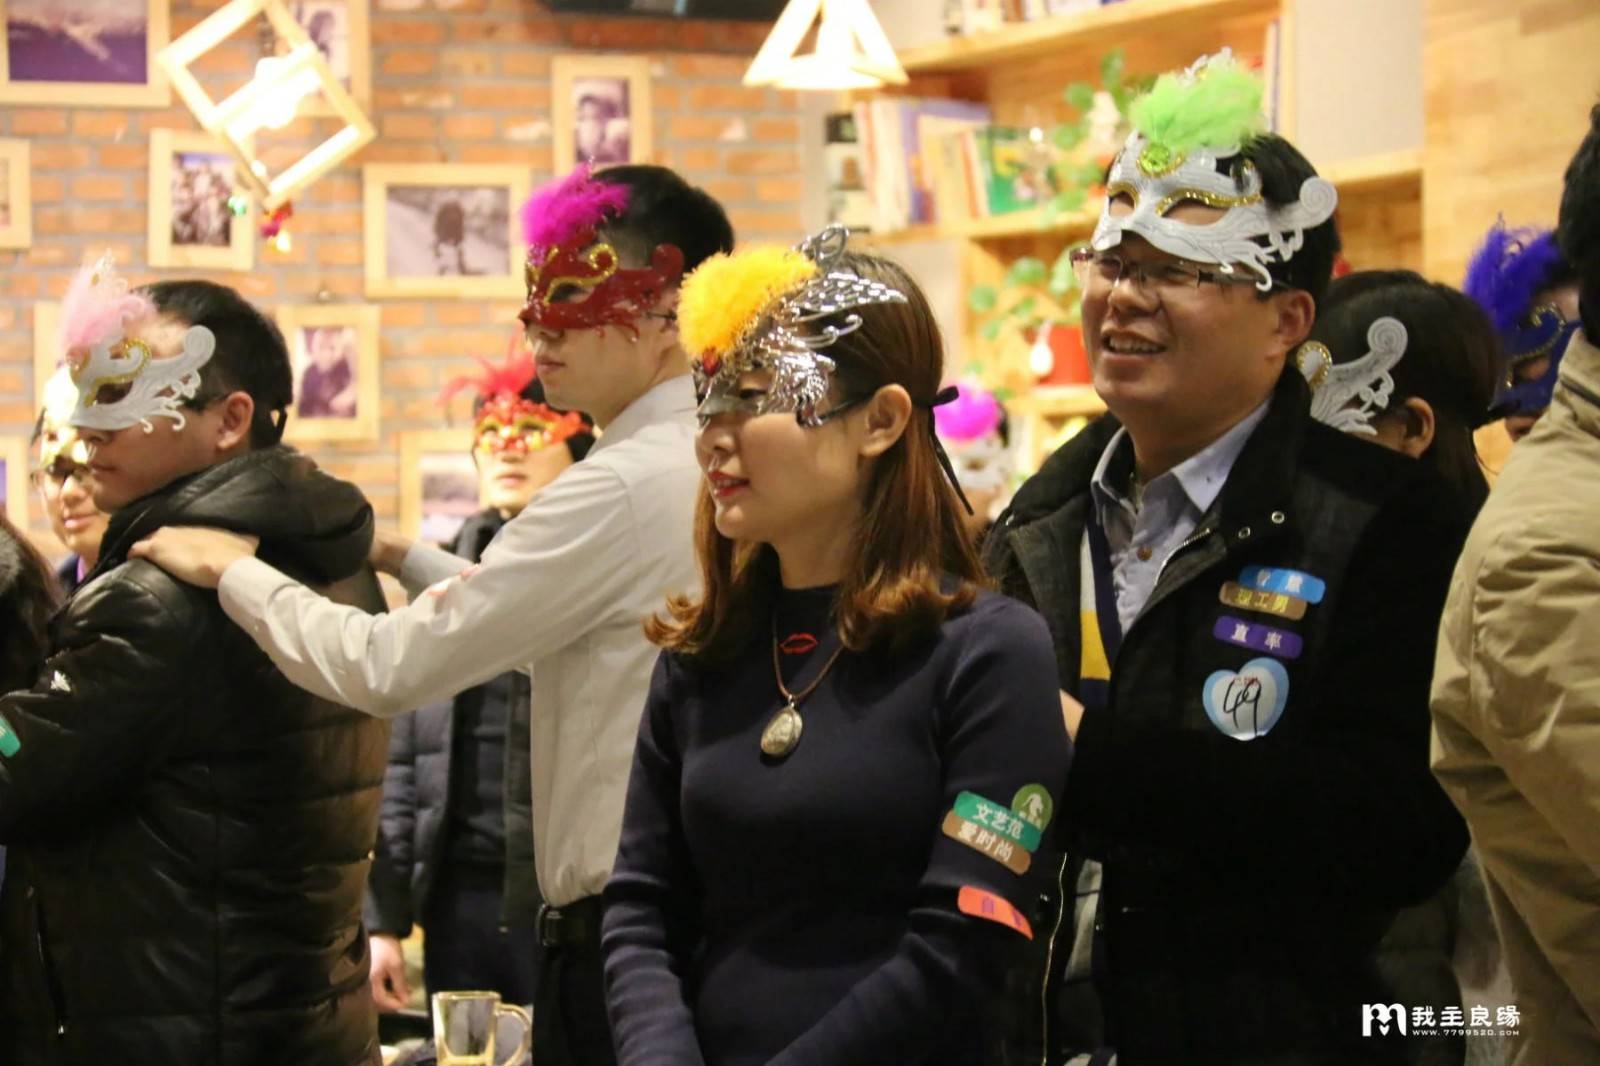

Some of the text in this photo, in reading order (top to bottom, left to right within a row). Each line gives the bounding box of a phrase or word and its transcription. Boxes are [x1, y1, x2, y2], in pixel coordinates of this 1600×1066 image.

[1231, 623, 1282, 650] 直率
[1223, 679, 1262, 736] 49
[958, 820, 1013, 862] 爱时尚
[972, 803, 1025, 840] 文艺范
